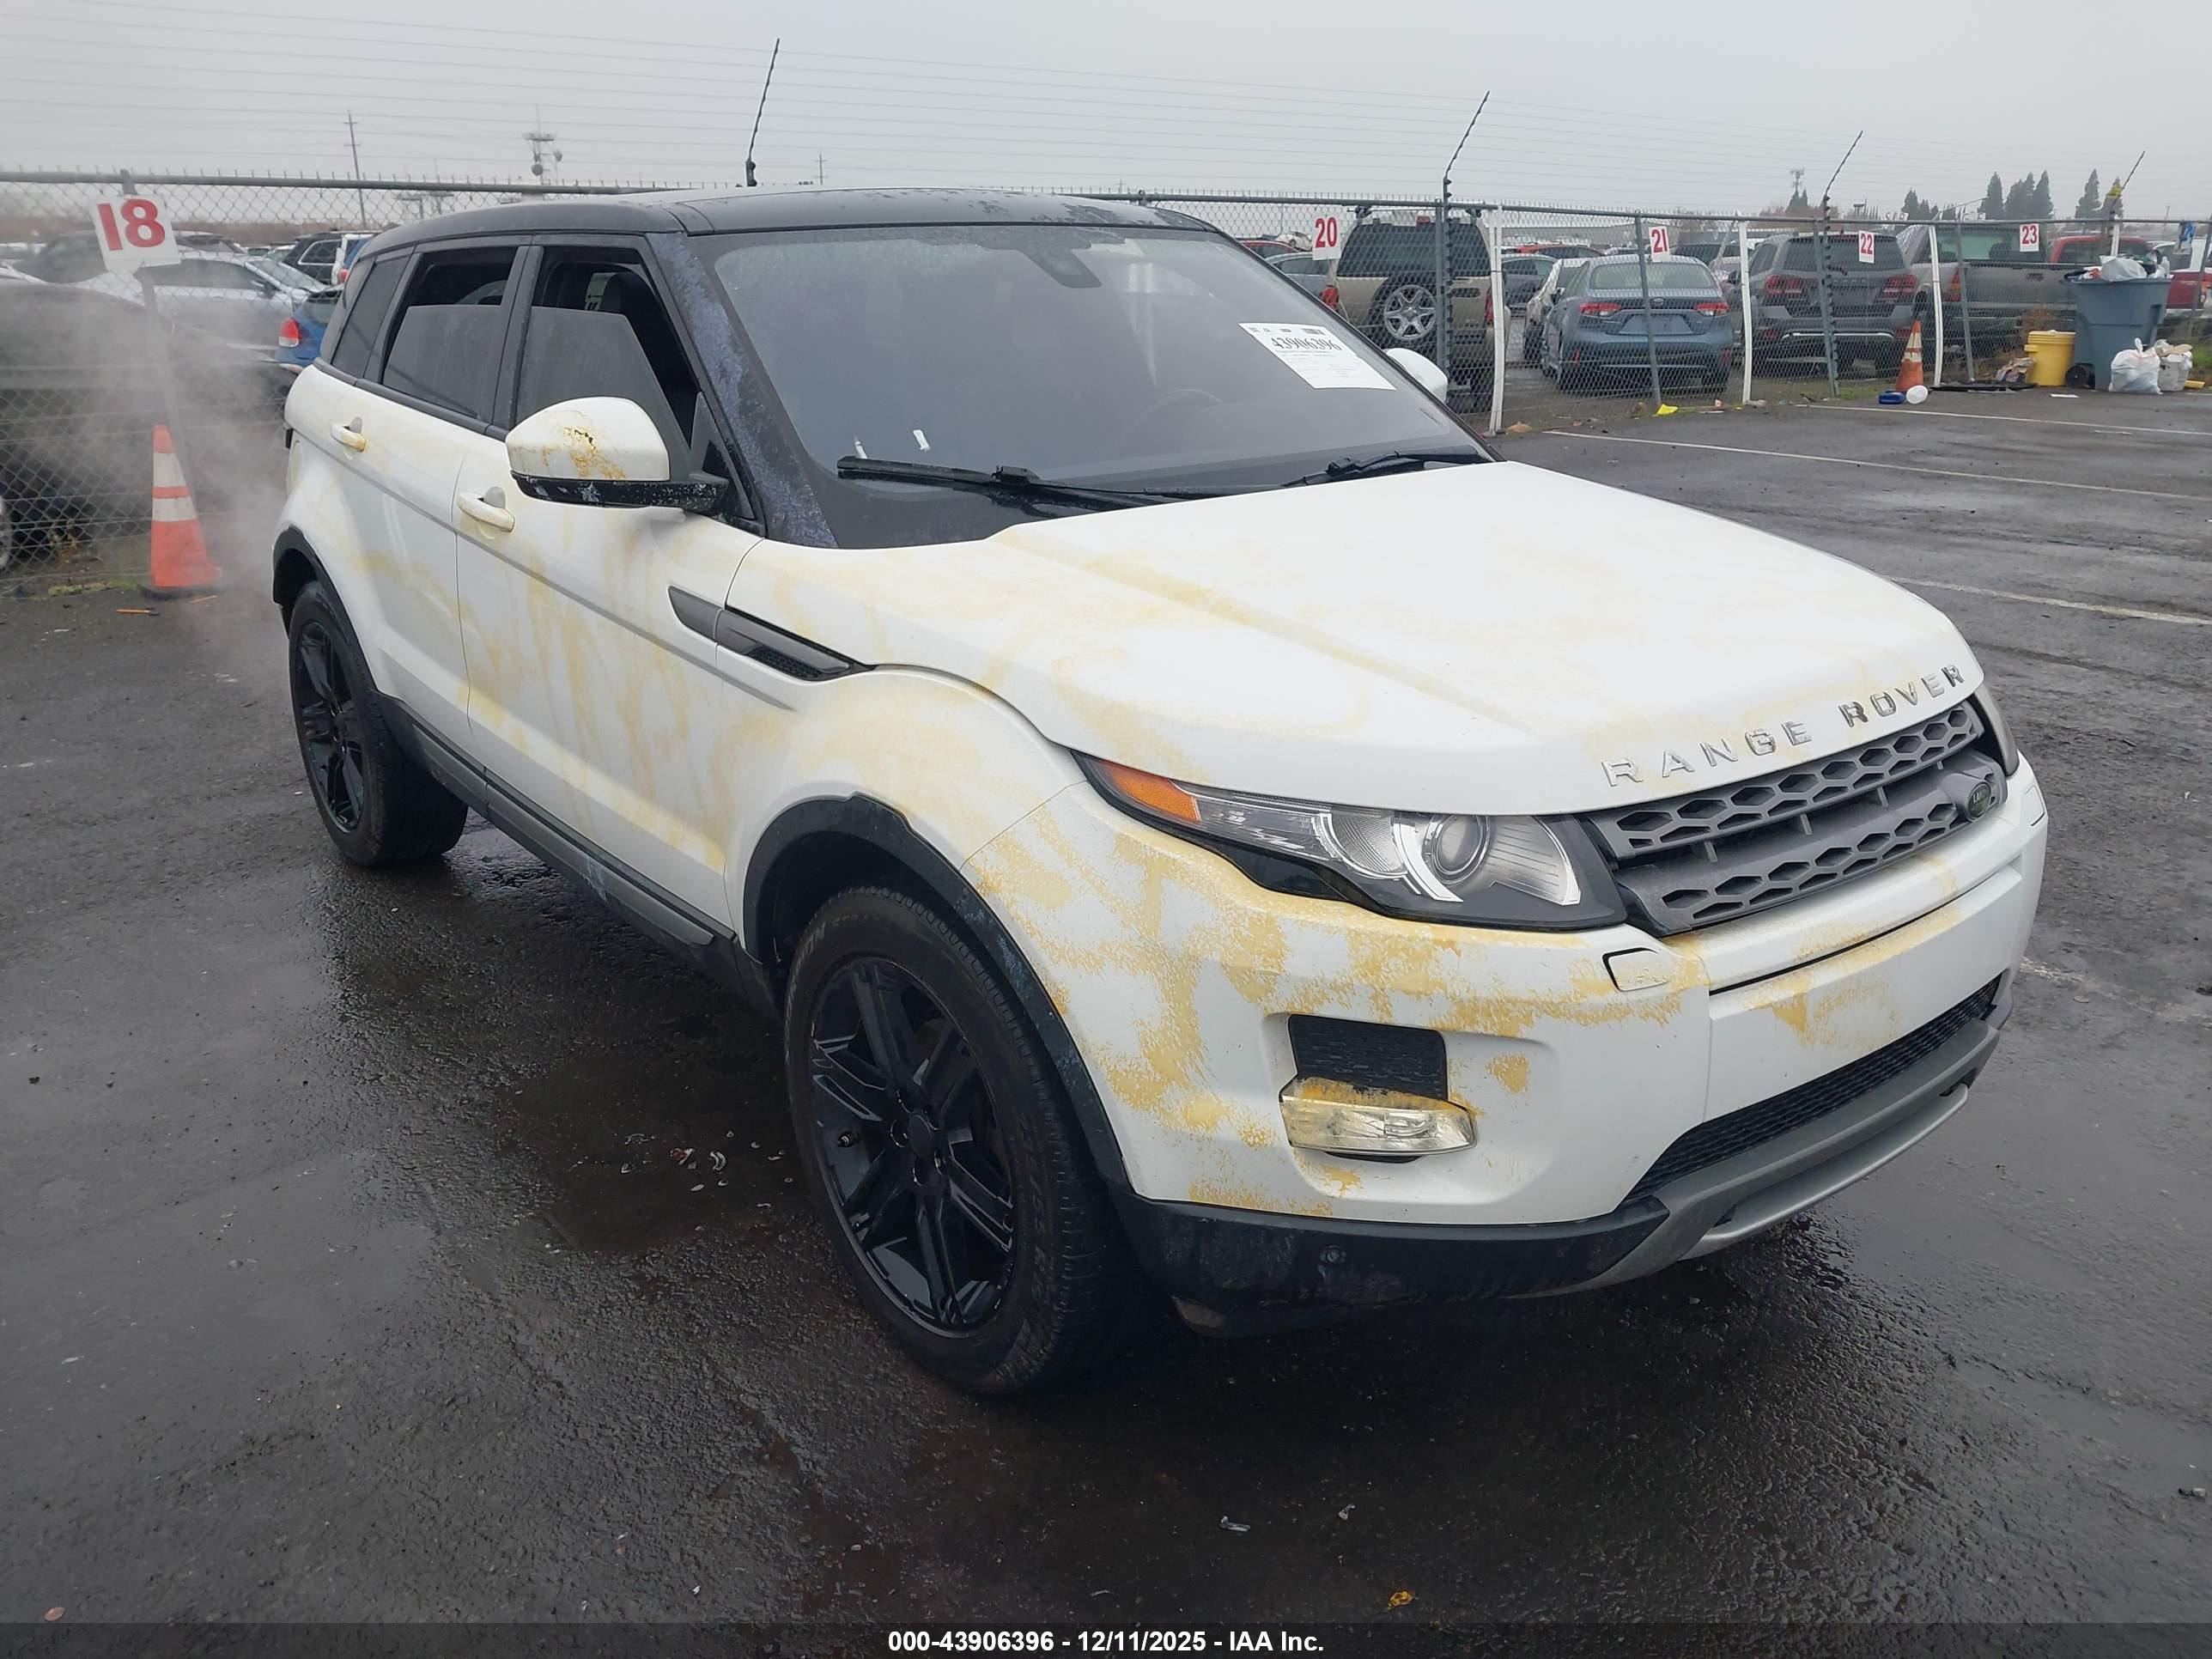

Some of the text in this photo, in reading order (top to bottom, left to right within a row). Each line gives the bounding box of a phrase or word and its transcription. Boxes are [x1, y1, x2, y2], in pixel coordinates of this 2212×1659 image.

[97, 198, 166, 251] 18
[1314, 216, 1338, 249] 20
[2021, 225, 2039, 246] 23
[1650, 228, 1668, 253] 21
[1860, 233, 1874, 255] 22
[1271, 337, 1343, 351] 43906396
[1601, 664, 1966, 787] RANGE ROVER
